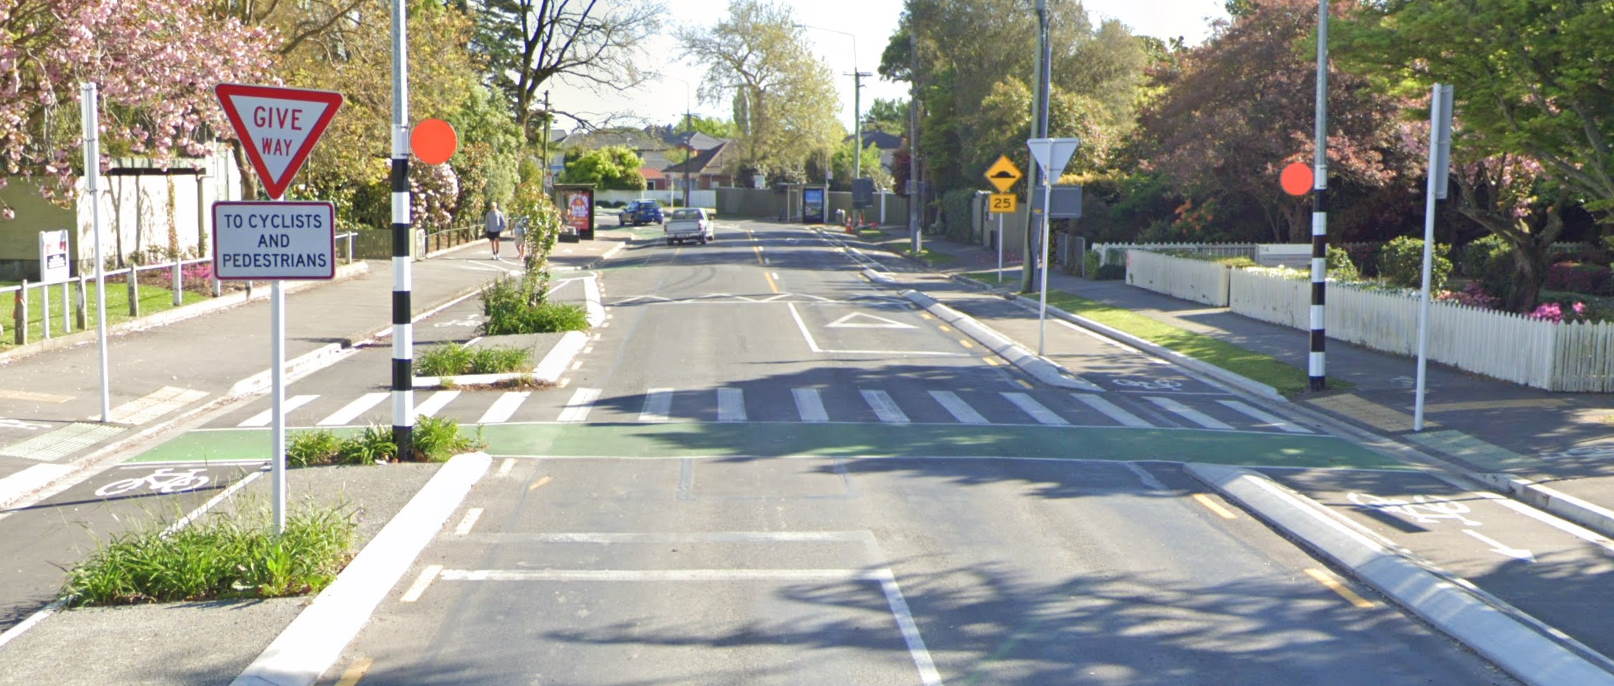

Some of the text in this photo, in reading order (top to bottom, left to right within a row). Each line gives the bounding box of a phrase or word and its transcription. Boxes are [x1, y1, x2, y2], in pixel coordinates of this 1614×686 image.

[254, 106, 303, 130] GIVE
[262, 137, 292, 156] WAY
[993, 198, 1011, 208] 25
[224, 214, 322, 229] TO CYCLISTS
[257, 234, 290, 248] AND
[222, 253, 327, 268] PEDESTRIANS
